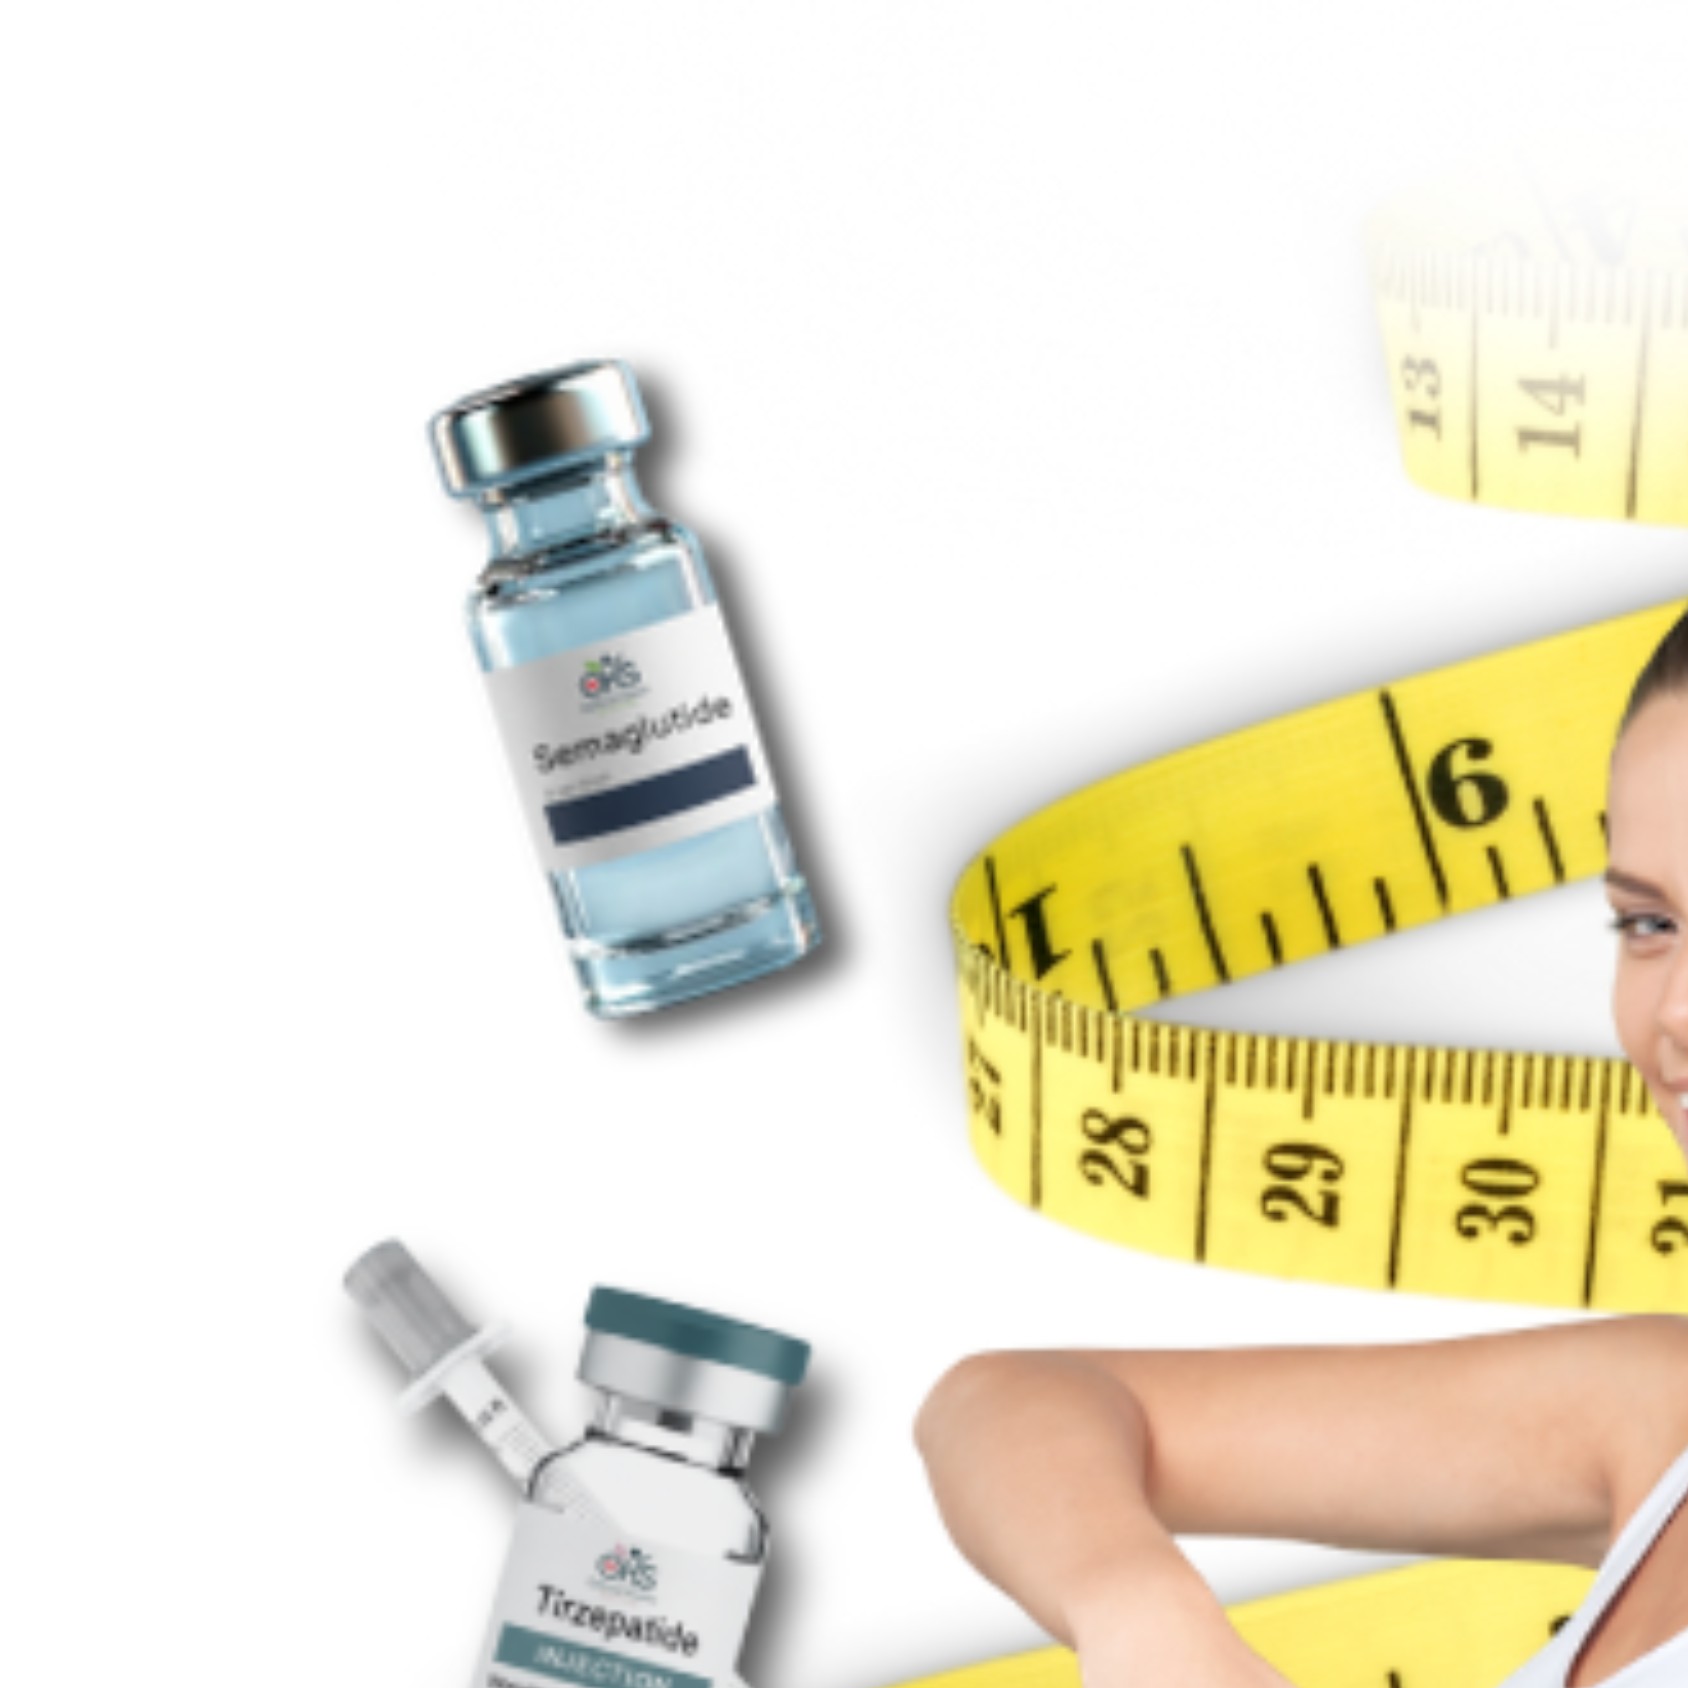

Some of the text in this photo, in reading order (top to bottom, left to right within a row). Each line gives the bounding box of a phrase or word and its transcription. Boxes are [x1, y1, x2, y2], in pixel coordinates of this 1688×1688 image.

[1404, 358, 1441, 440] 13
[1516, 371, 1585, 459] 14
[533, 695, 731, 774] Semaglutide
[1079, 1108, 1152, 1200] 28
[1260, 1142, 1345, 1228] 29
[1456, 1158, 1540, 1246] 30
[537, 1585, 699, 1656] Tirzepatide
